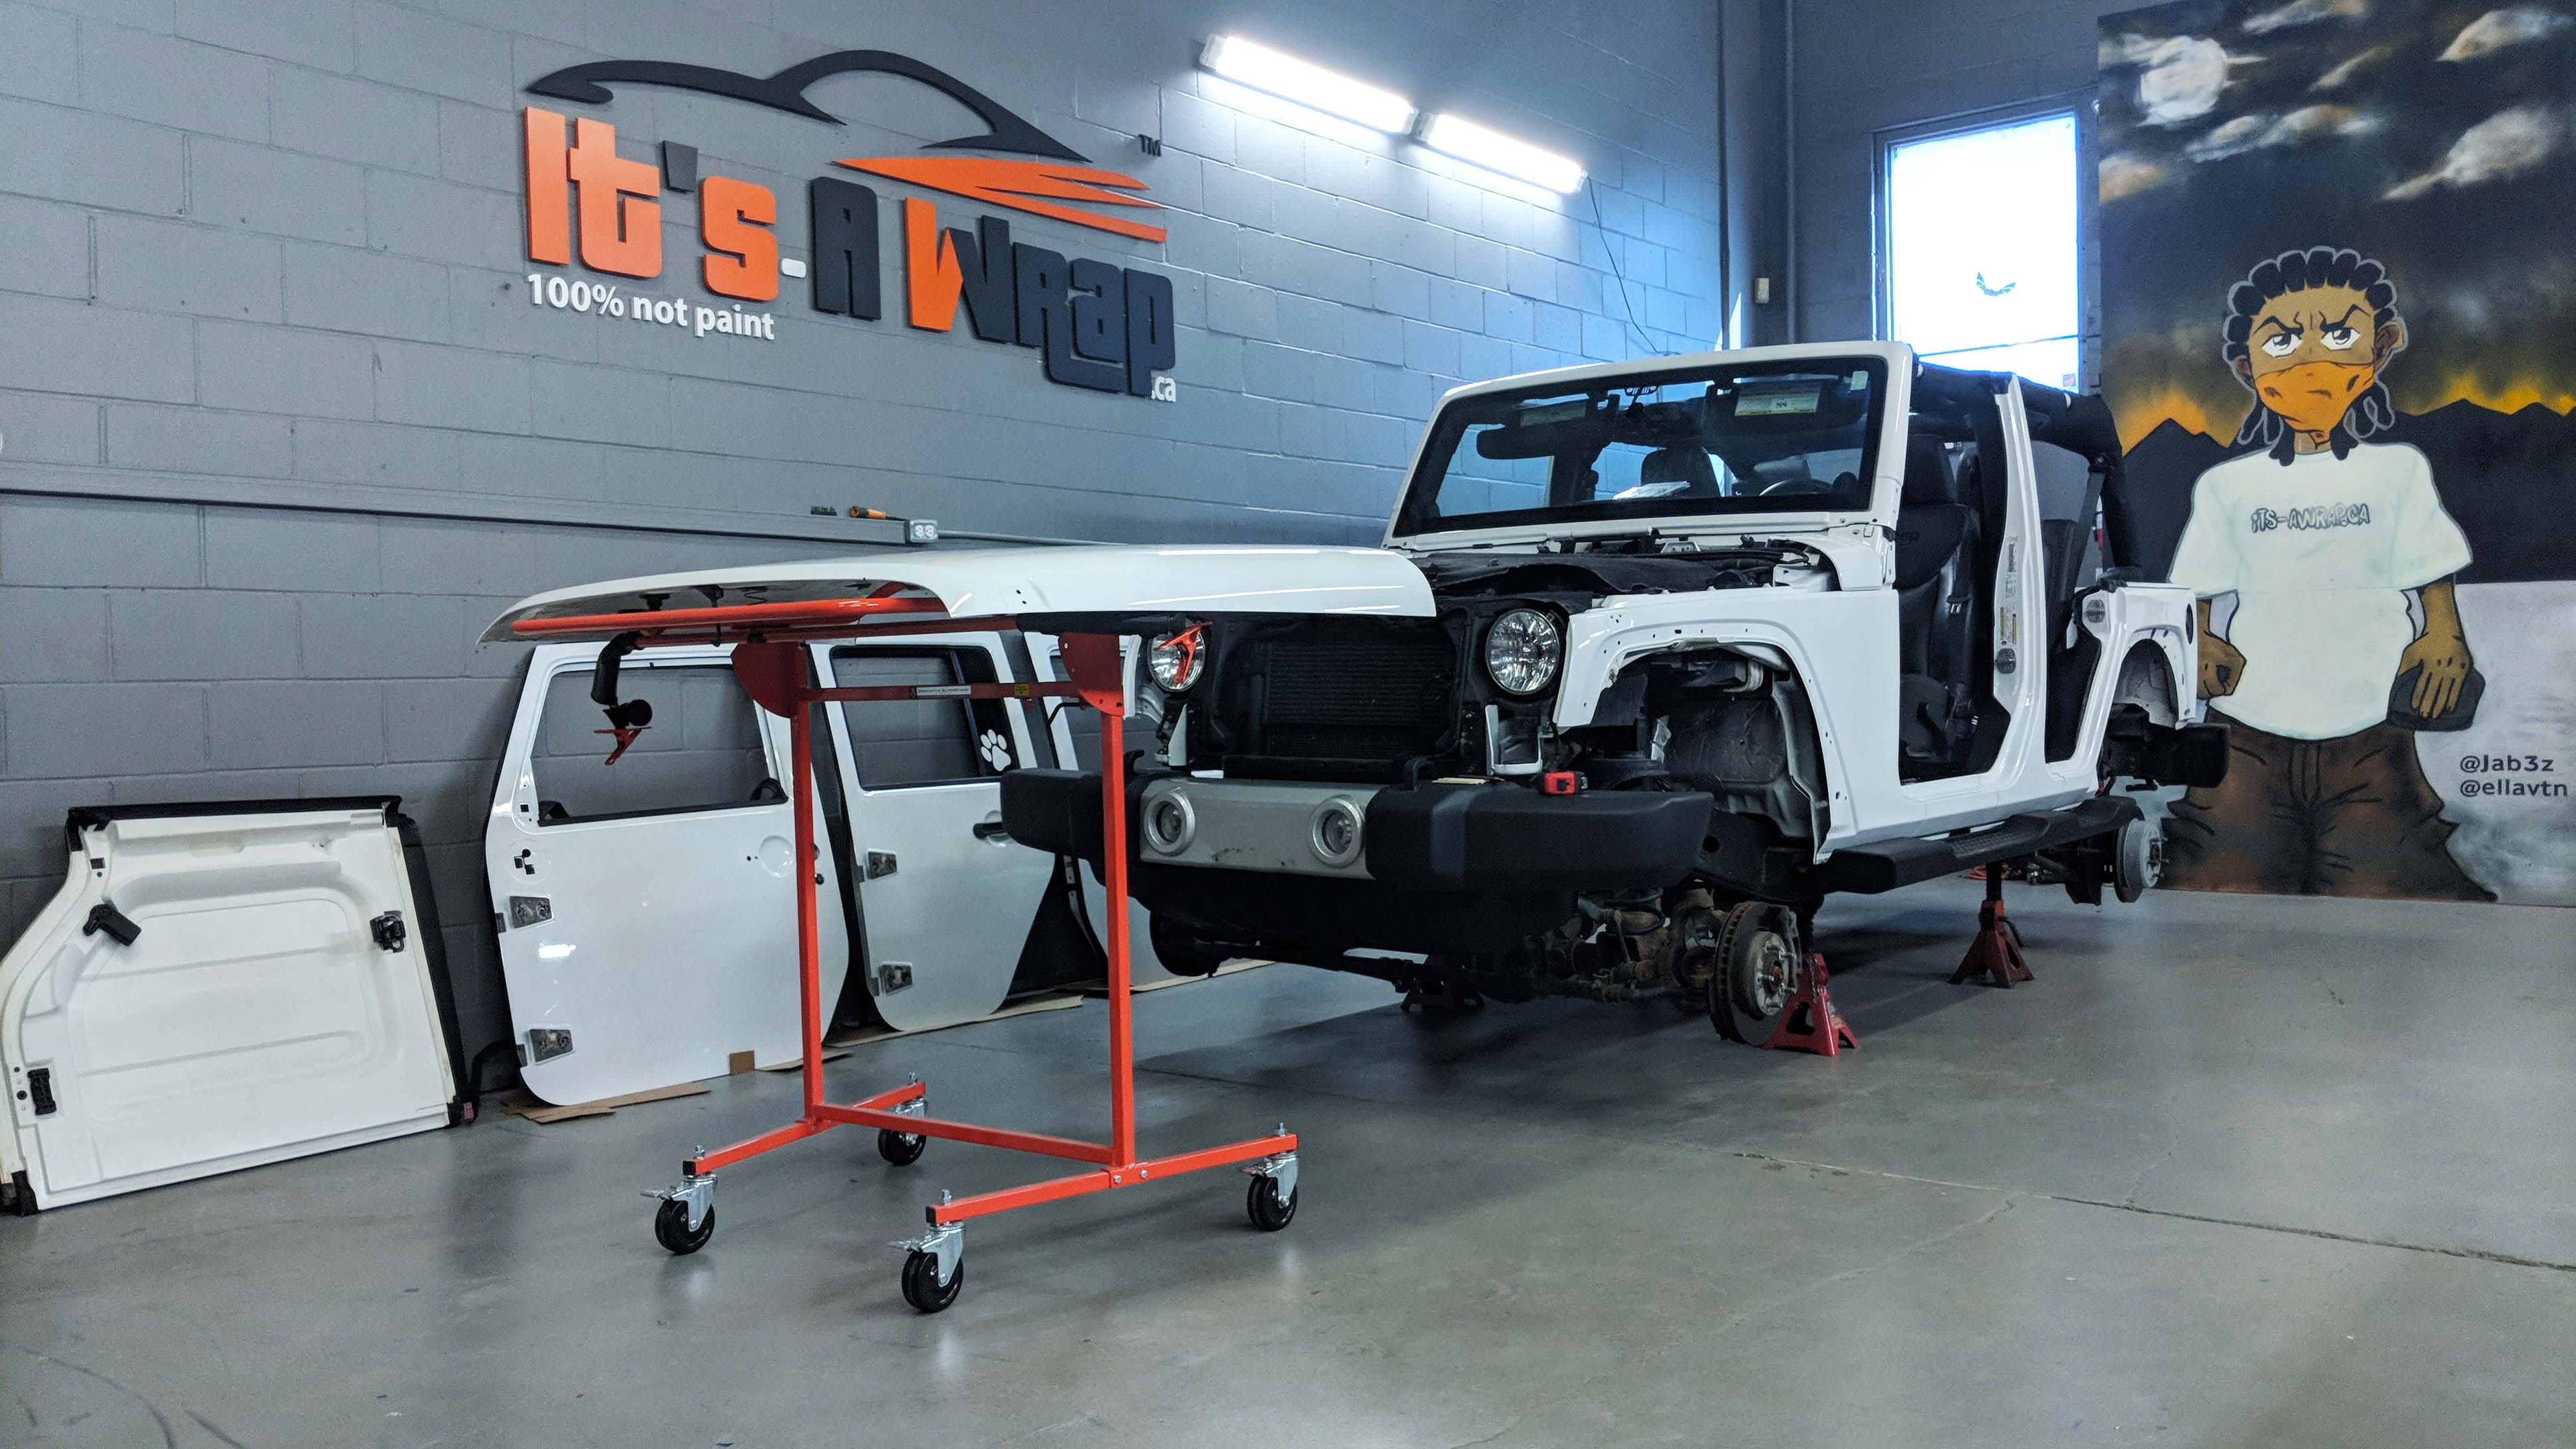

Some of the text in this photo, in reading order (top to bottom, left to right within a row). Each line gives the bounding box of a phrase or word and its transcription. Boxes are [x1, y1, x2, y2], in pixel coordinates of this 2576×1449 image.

[527, 273, 775, 341] 100% not paint
[2460, 755, 2555, 773] @Jab3z
[2460, 778, 2569, 797] @ellavtn
